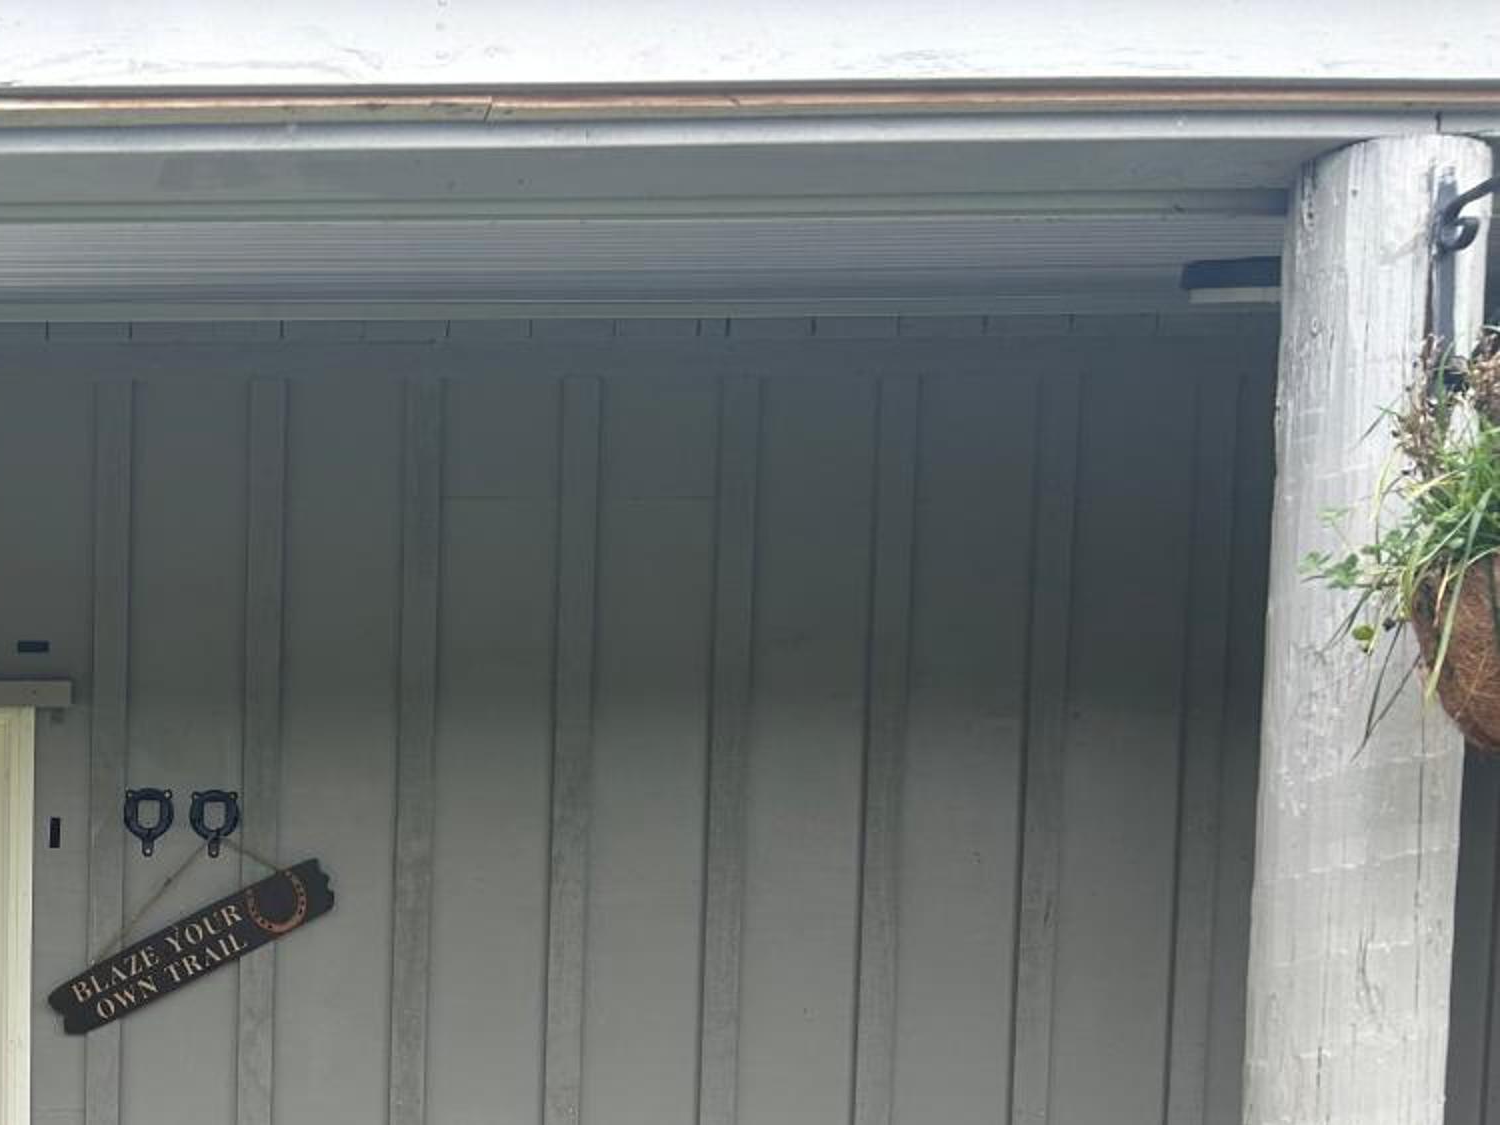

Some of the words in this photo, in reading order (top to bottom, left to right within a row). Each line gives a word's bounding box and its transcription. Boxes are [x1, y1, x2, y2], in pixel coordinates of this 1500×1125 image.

[71, 946, 159, 1003] BLAZE
[164, 904, 242, 953] YOUR
[96, 975, 158, 1020] OWN
[163, 933, 247, 982] TRAIL
